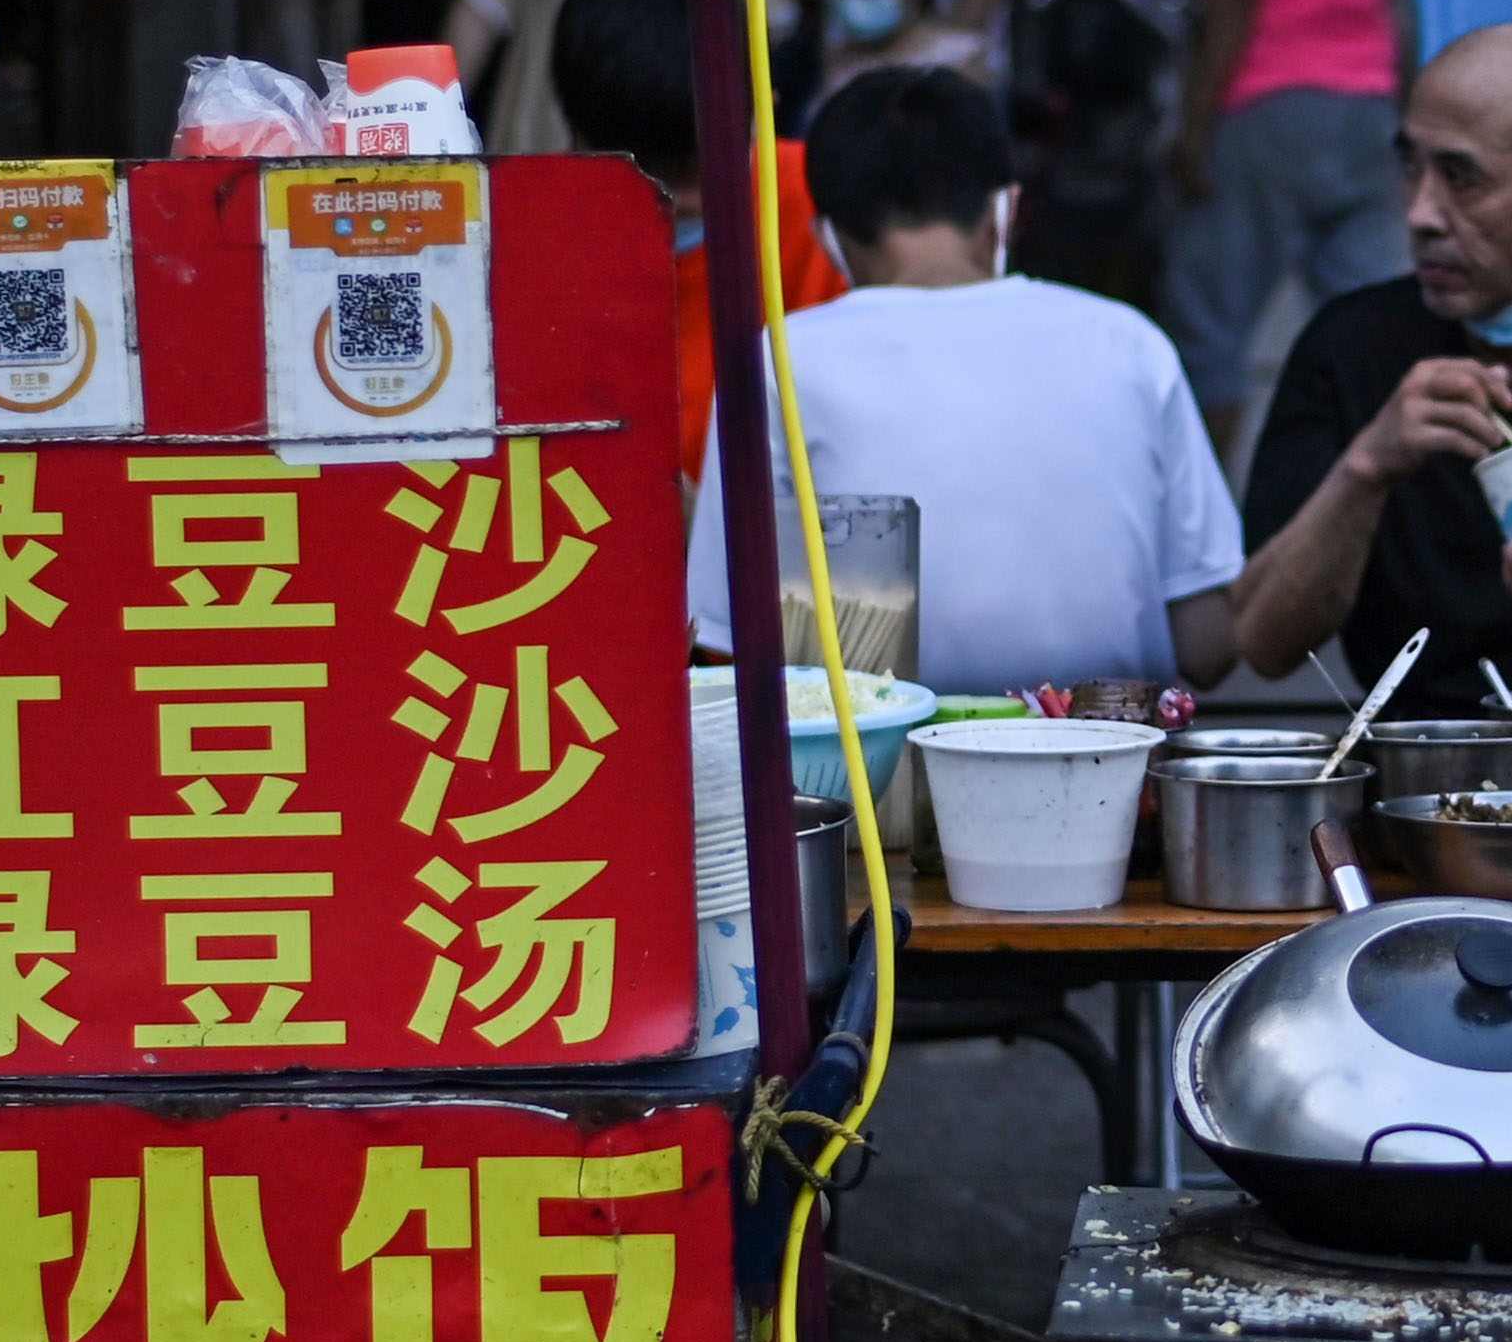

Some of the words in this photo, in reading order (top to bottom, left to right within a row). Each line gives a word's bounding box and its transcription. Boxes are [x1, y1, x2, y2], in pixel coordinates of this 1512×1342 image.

[313, 190, 443, 214] 在此扫码付款
